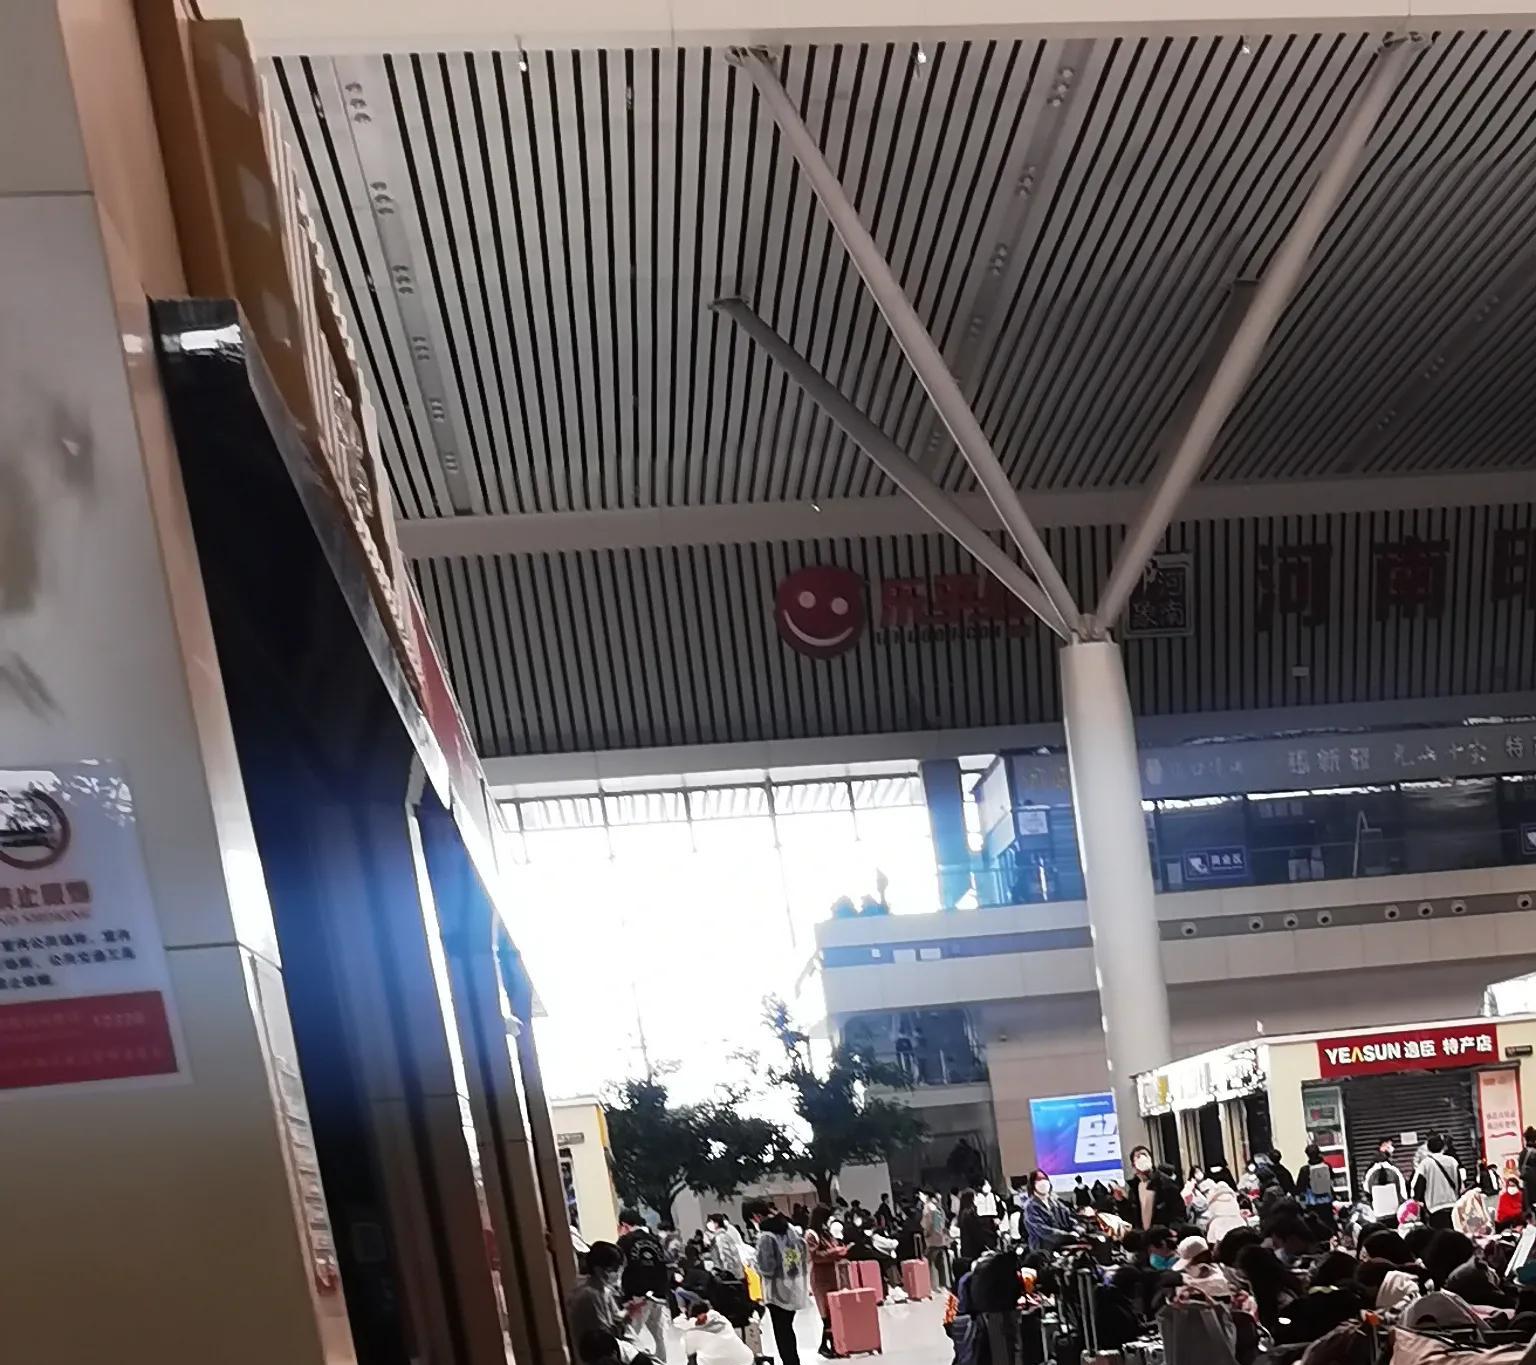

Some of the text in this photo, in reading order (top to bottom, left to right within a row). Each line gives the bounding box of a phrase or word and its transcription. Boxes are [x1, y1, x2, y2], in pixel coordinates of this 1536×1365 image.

[1325, 1042, 1401, 1065] YEASUN
[1442, 1035, 1492, 1056] 特产店
